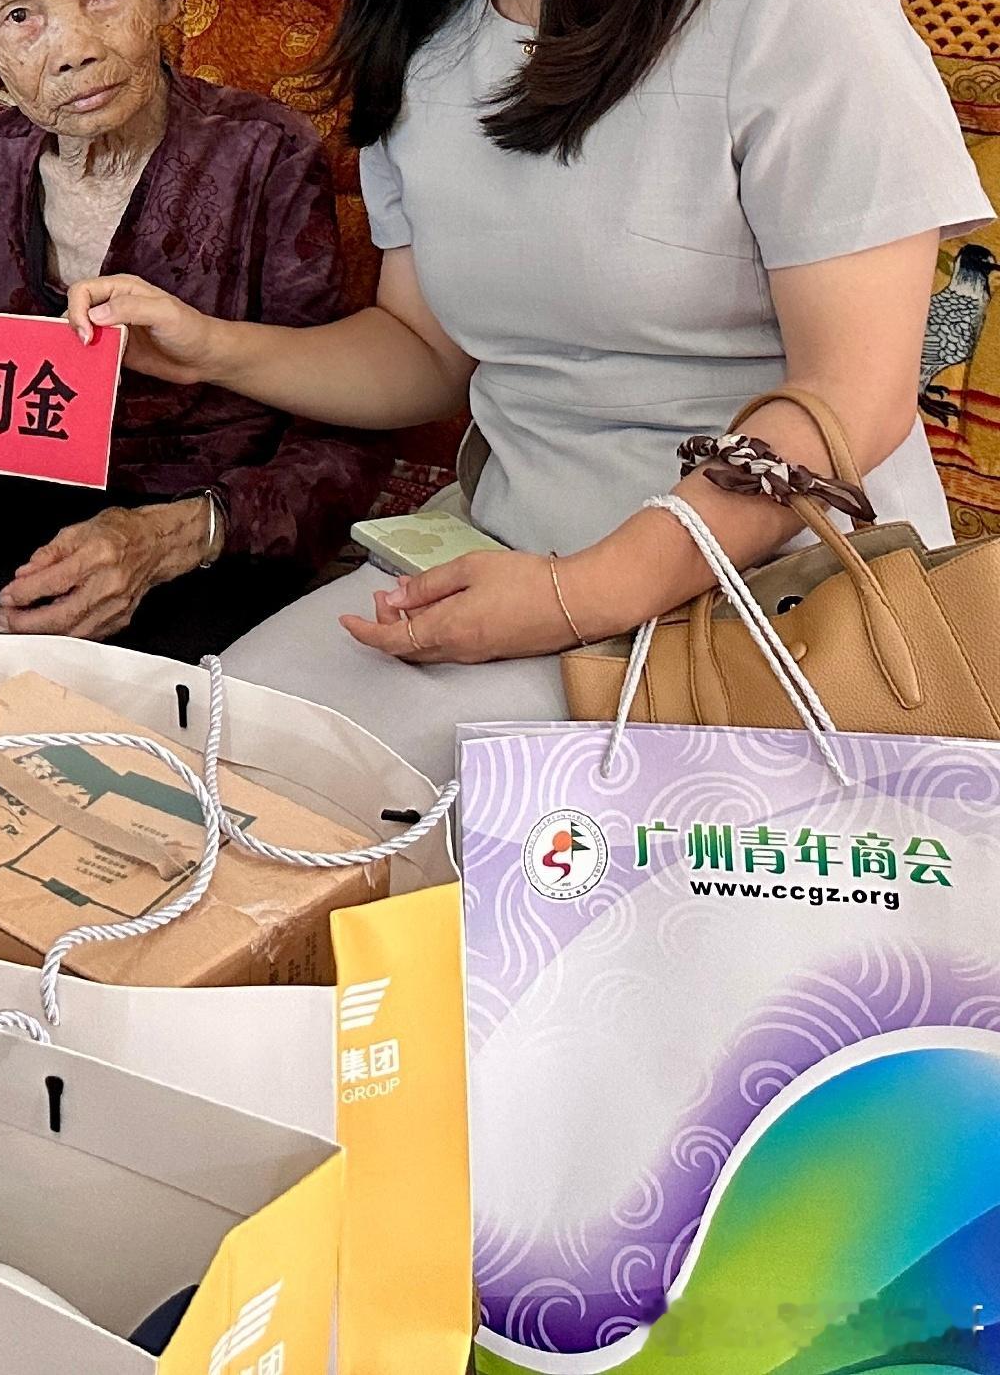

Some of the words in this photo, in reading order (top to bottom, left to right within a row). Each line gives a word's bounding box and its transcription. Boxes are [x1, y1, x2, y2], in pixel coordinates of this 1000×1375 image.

[636, 821, 953, 888] 广州青年商会
[689, 880, 900, 911] www.ccgz.org
[340, 1038, 400, 1085] 集团
[341, 1076, 401, 1104] GROUP
